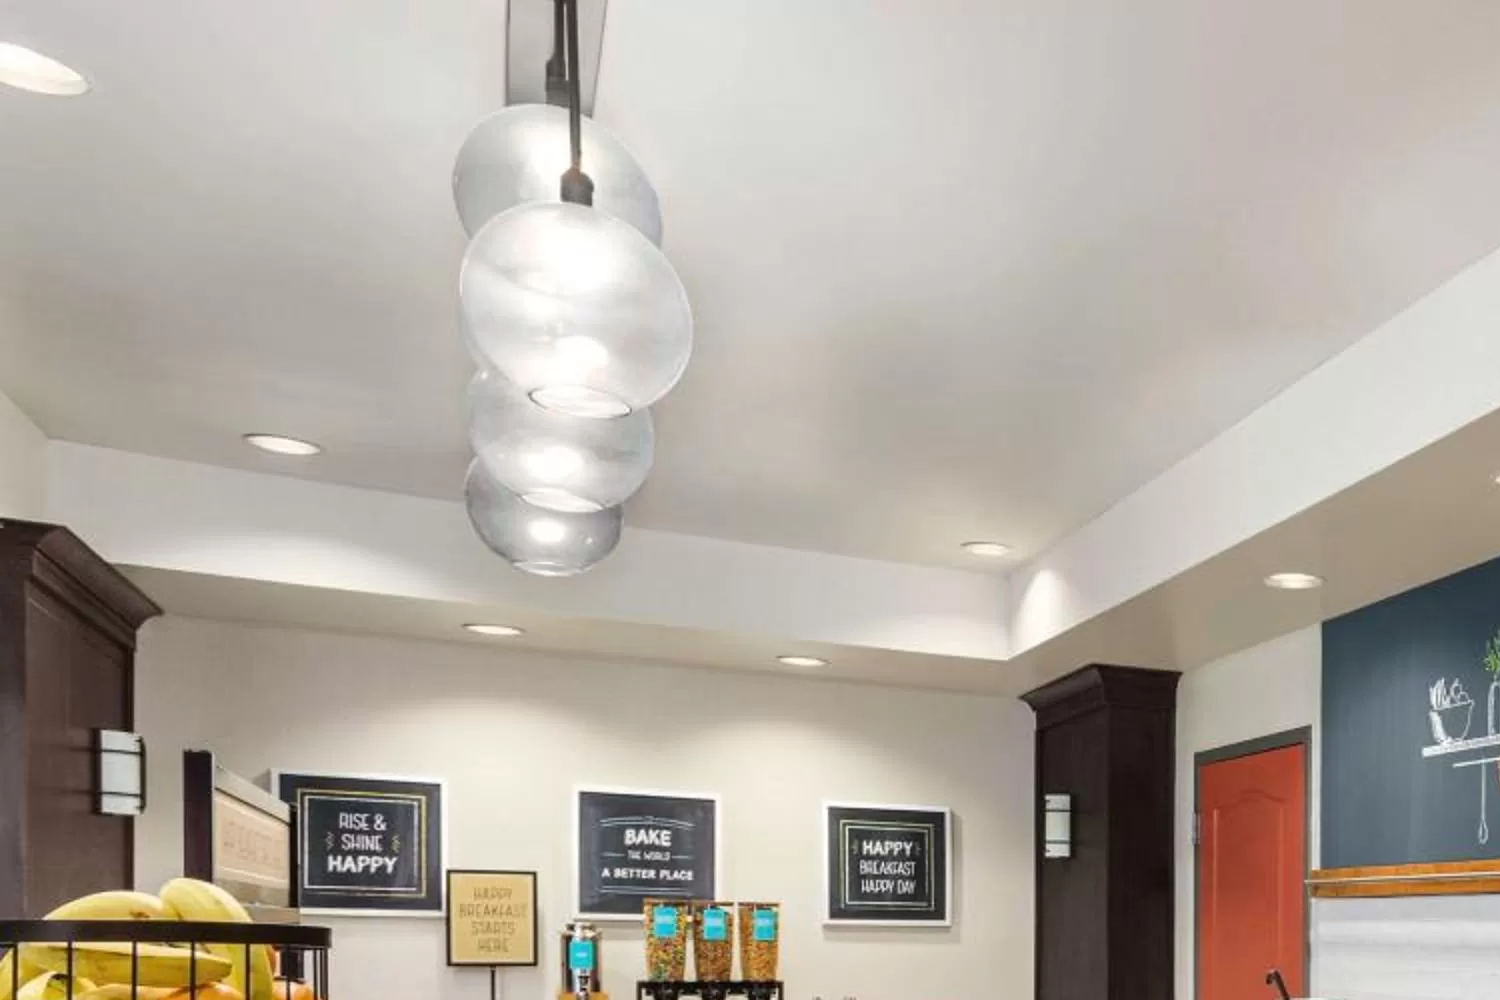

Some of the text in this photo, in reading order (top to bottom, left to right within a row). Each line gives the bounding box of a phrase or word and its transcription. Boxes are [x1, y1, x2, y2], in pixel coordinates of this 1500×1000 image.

[339, 811, 388, 832] RISE &
[340, 833, 383, 853] SHINE
[624, 827, 672, 848] BAKE
[862, 839, 914, 857] HAPPY
[327, 853, 399, 875] HAPPY
[859, 859, 917, 876] BREAKFAST
[601, 867, 694, 881] A BETTER PLACE
[861, 879, 895, 894] HAPPY
